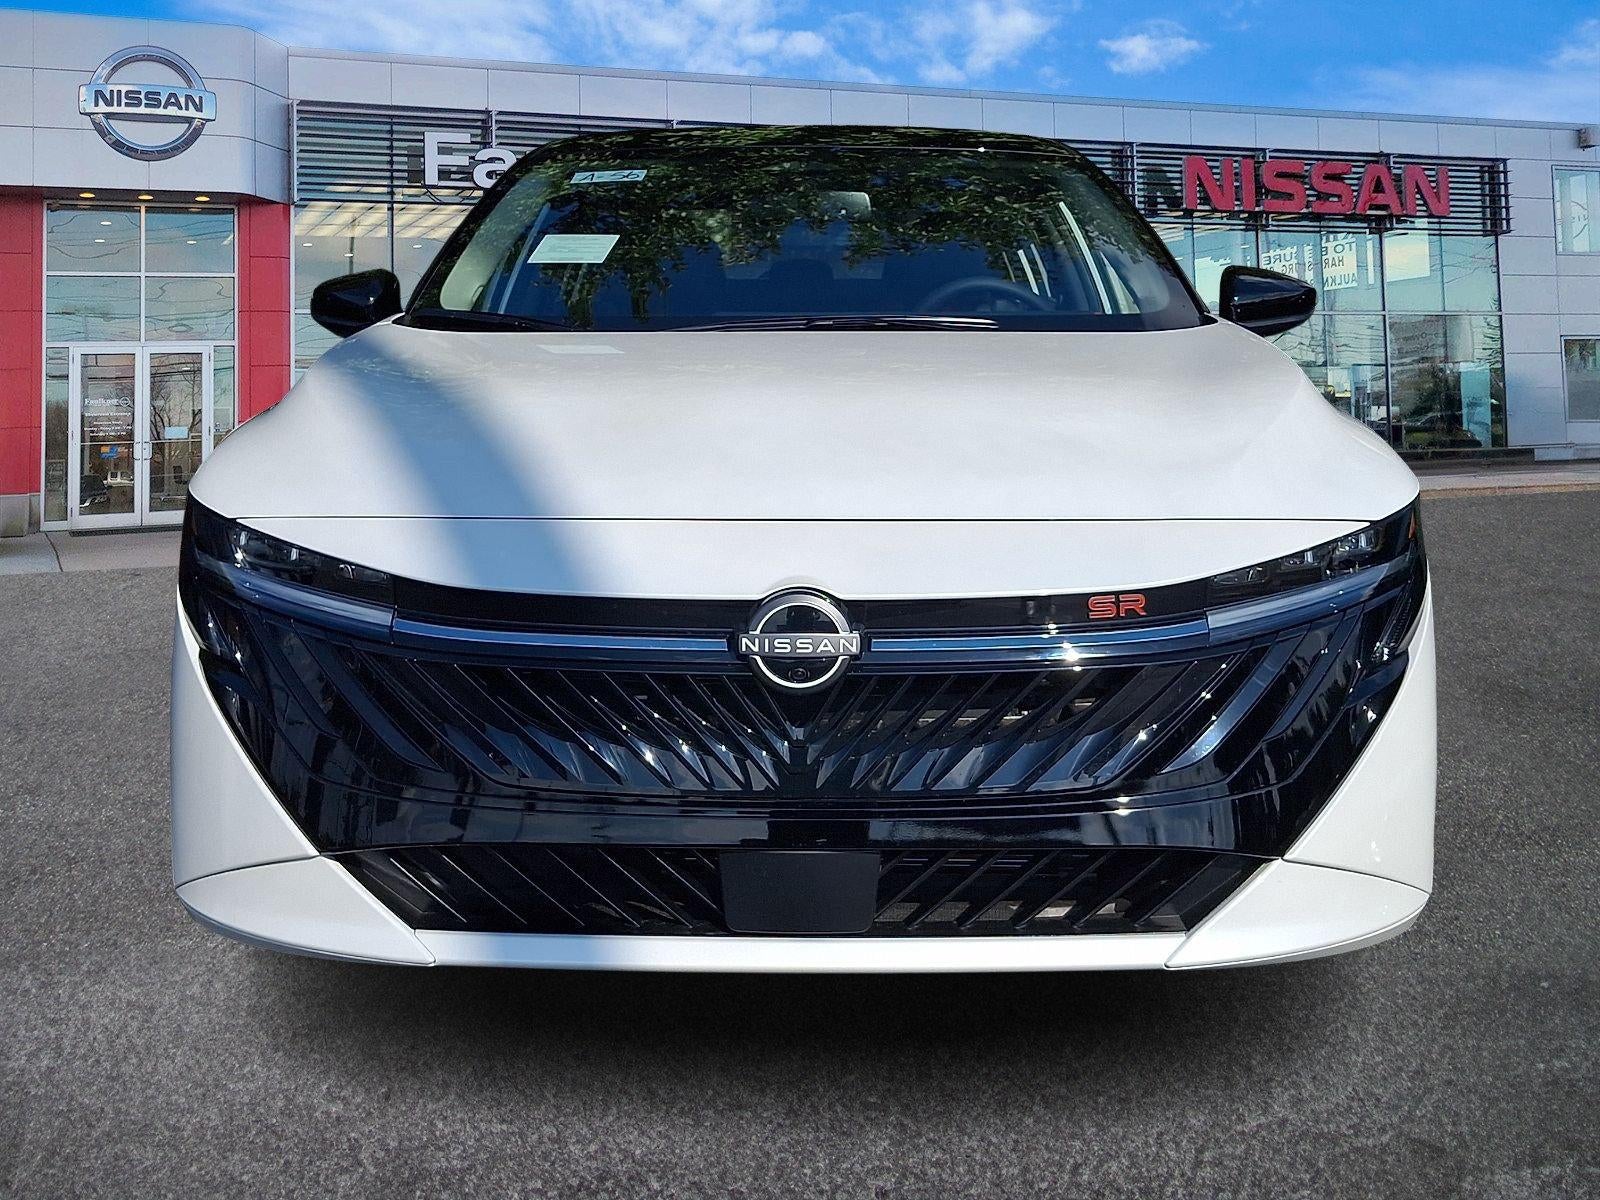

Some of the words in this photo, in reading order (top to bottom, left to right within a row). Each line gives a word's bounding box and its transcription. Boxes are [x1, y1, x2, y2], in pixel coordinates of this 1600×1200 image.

[93, 88, 204, 113] NISSAN
[1182, 154, 1451, 217] NISSAN
[1088, 593, 1147, 619] SR
[741, 637, 857, 653] NISSAN
